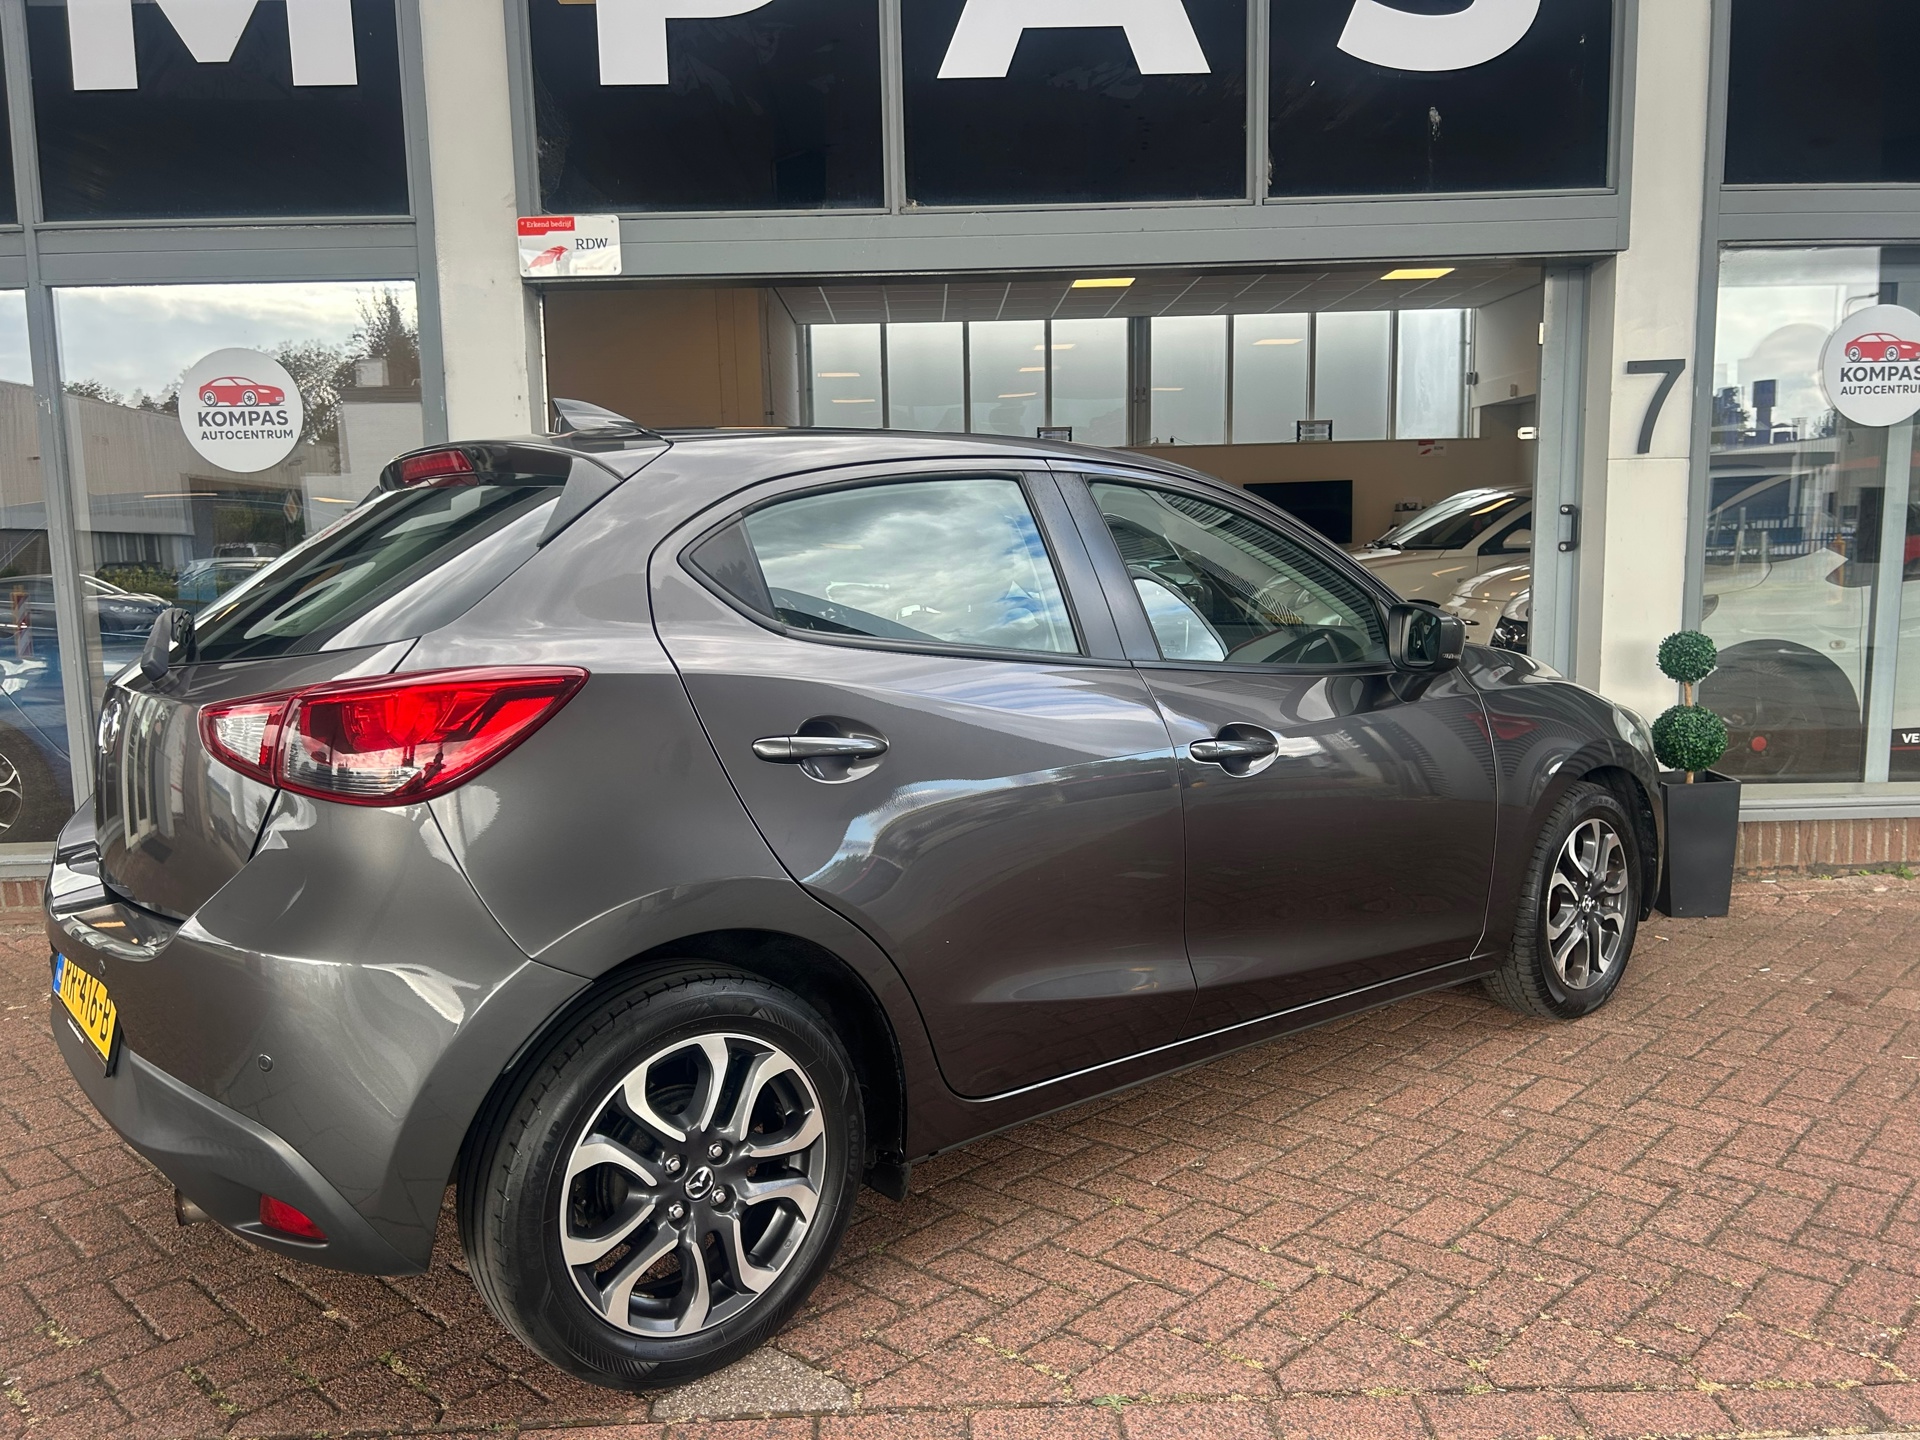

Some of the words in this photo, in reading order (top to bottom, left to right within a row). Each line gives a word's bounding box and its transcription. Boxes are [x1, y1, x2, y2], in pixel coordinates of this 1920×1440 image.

[550, 220, 572, 229] bedrijf
[575, 238, 609, 250] RDW
[1841, 384, 1920, 396] AUTOCENTRU
[1627, 358, 1686, 455] 7
[197, 410, 289, 427] KOMPAS
[201, 429, 294, 440] AUTOCENTRUM
